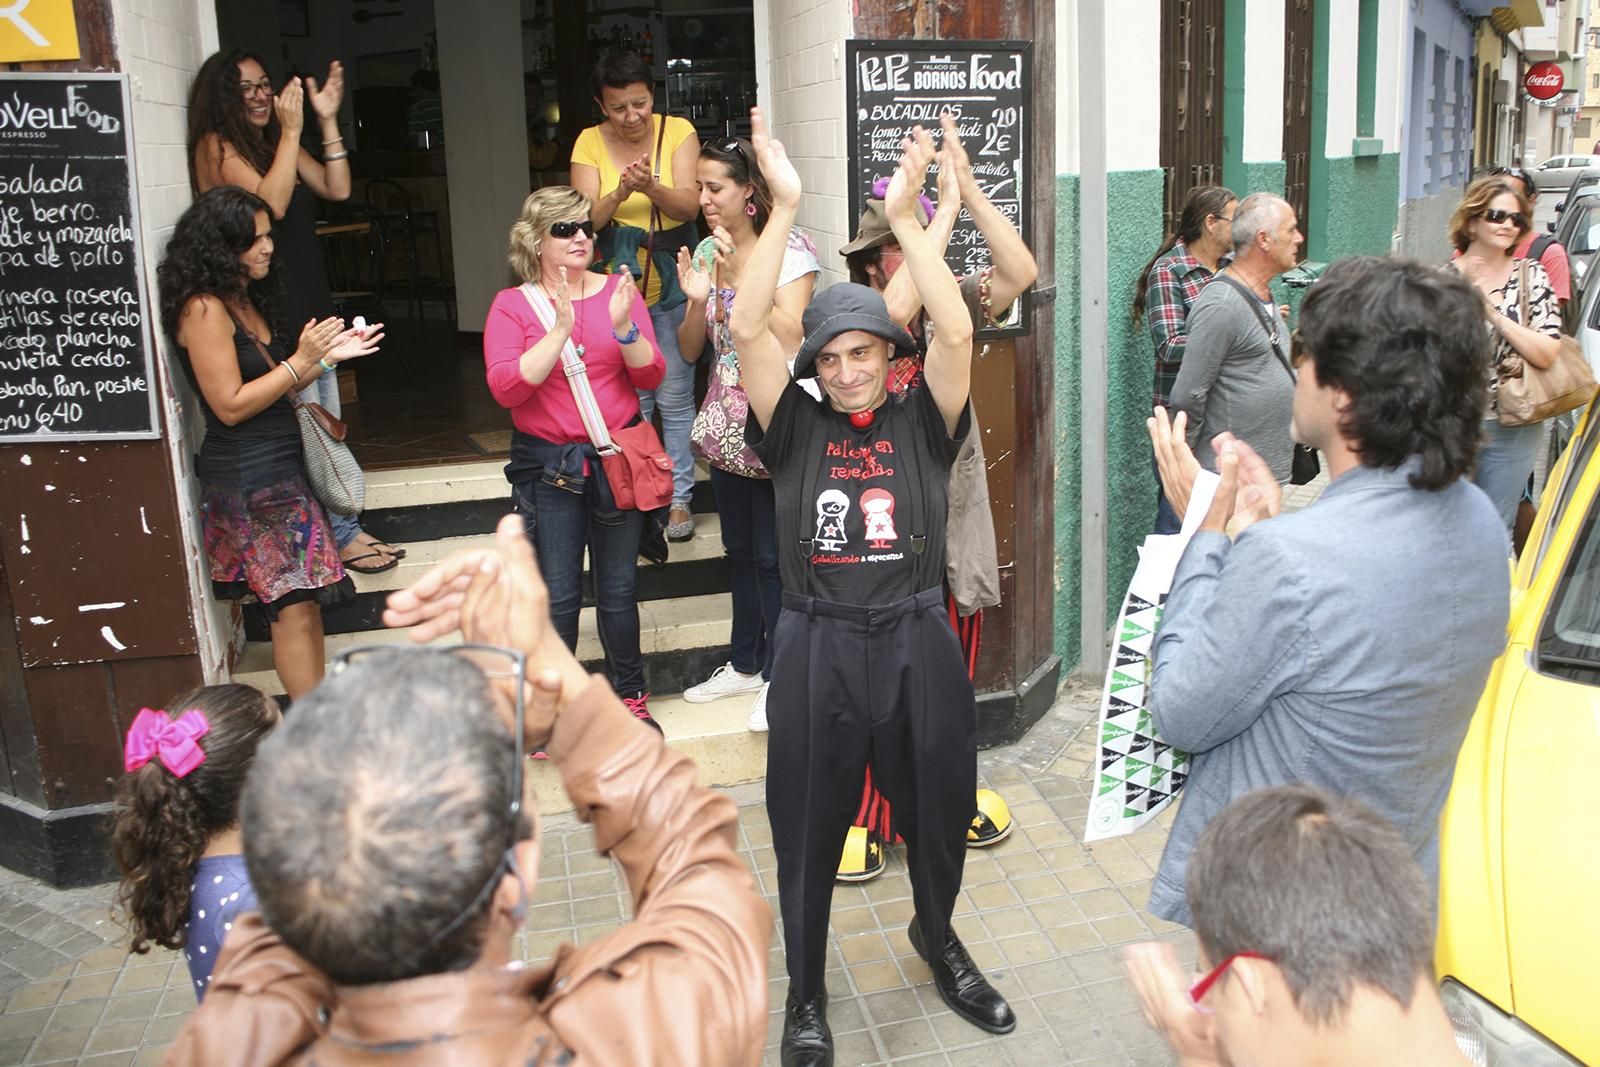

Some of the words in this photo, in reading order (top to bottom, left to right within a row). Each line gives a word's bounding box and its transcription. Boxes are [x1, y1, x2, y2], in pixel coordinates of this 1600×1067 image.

[913, 71, 967, 90] BORNOS
[34, 245, 64, 267] de
[70, 245, 124, 272] pollo
[60, 303, 86, 327] de
[90, 304, 140, 327] cerdo
[56, 326, 136, 356] plancha
[95, 375, 148, 402] postre
[875, 440, 894, 454] en
